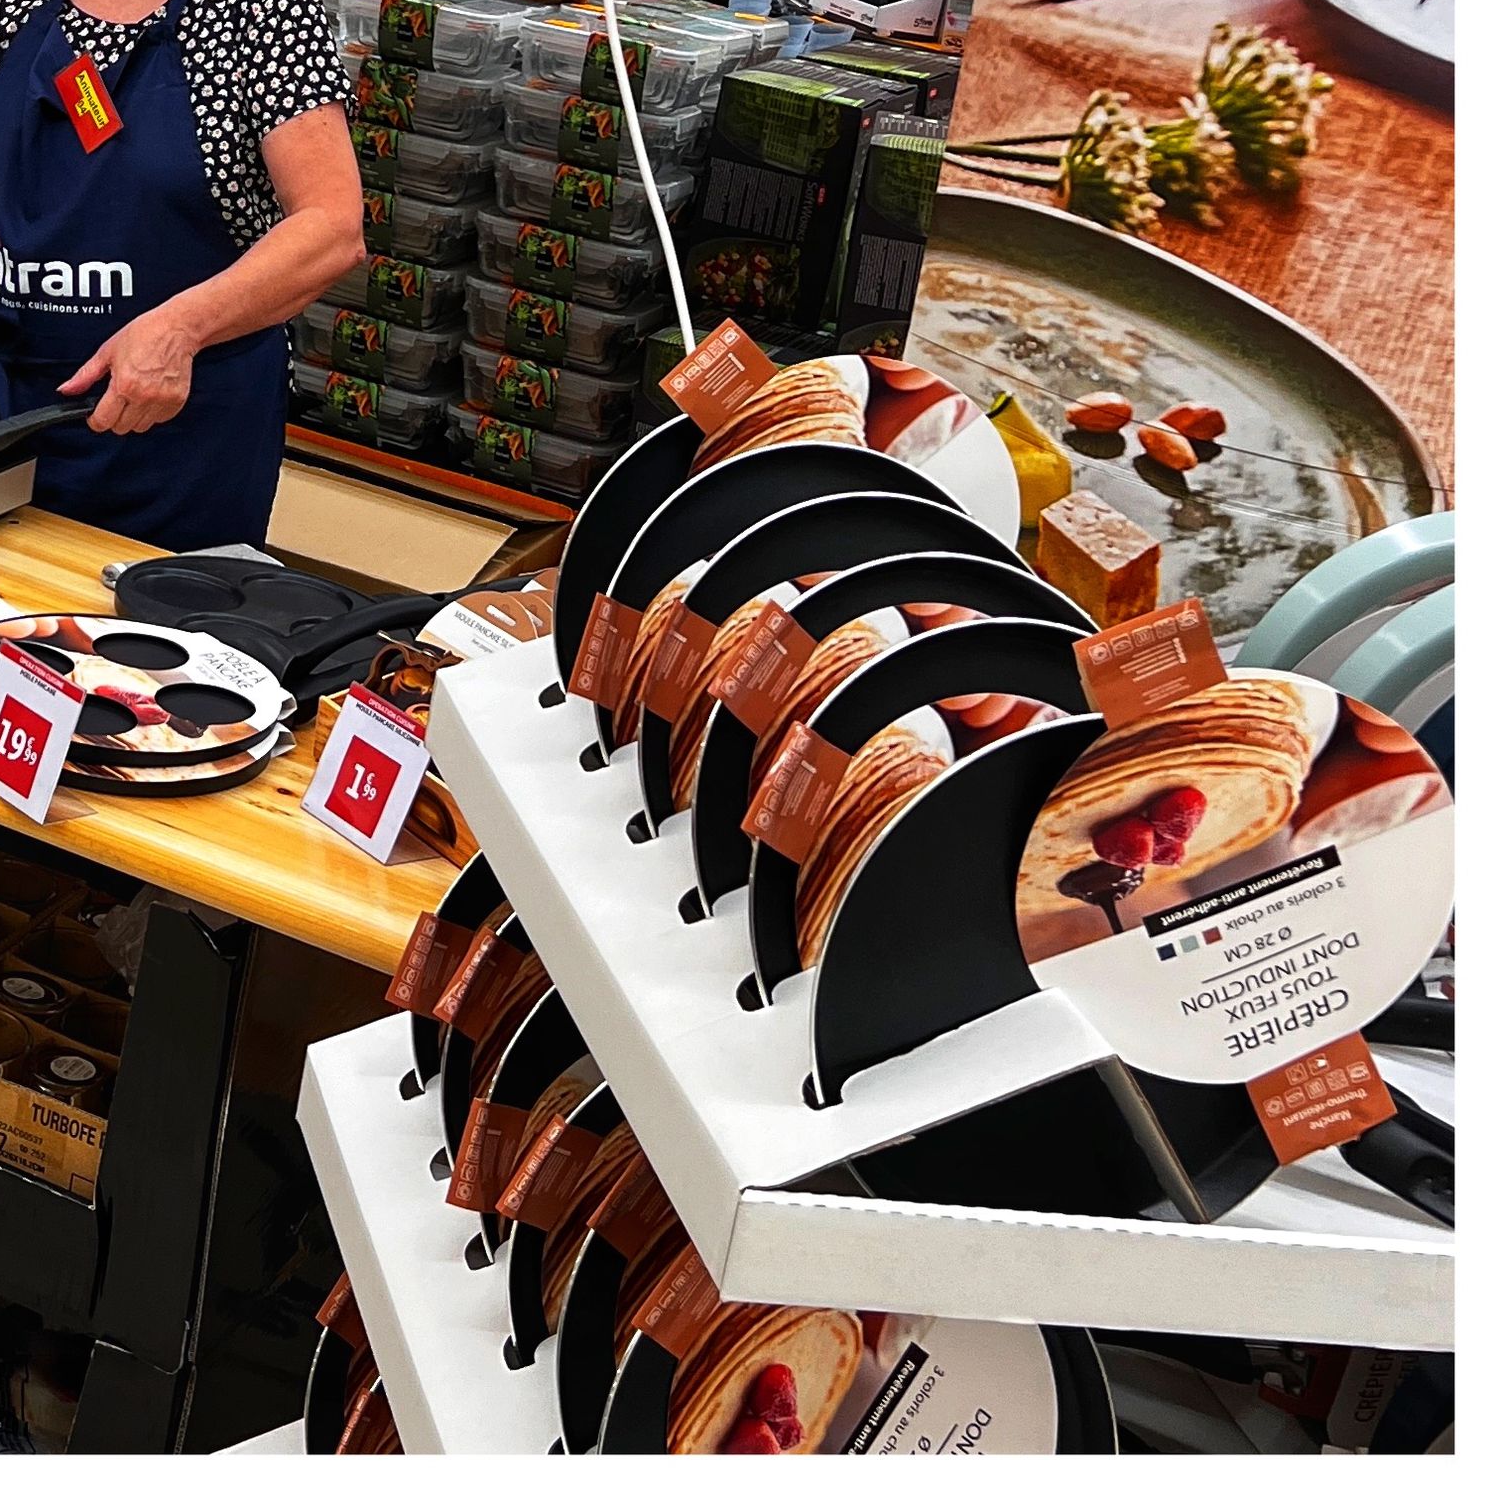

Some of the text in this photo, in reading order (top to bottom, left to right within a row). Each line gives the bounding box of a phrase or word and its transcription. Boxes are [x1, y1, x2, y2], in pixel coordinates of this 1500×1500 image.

[78, 73, 105, 126] Animateur
[28, 301, 79, 314] cuisinons
[82, 303, 104, 314] vrai
[1159, 857, 1324, 927] Revêtement anti-adhérent
[1224, 875, 1346, 931] 3 coloris au choix
[1223, 941, 1252, 963] CM
[1254, 932, 1275, 949] 28
[1180, 931, 1360, 1016] DONT INDUCTION
[1224, 966, 1338, 1025] TOUS FEUX
[1223, 989, 1349, 1058] CRÊPIÈRE
[31, 1102, 97, 1148] TURBOFE
[1309, 1109, 1353, 1131] Manche
[871, 1359, 917, 1428] Revêtement
[895, 1365, 945, 1435] 3 coloris au
